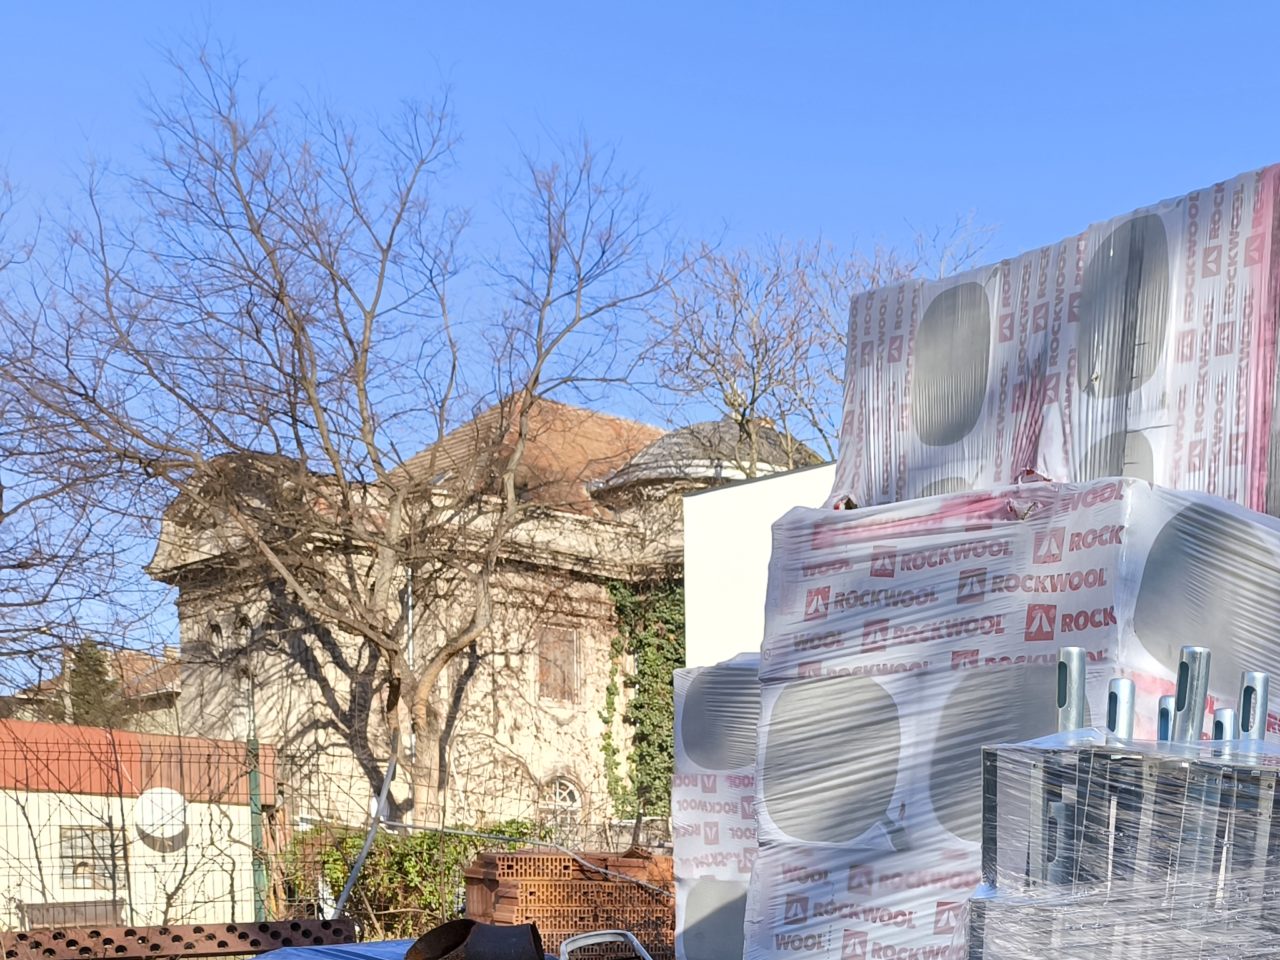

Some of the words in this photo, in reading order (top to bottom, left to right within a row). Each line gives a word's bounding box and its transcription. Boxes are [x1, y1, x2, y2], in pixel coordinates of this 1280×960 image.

[1184, 192, 1199, 323] ROCKWOOL
[1223, 184, 1244, 315] ROCKWOOL
[1048, 245, 1067, 367] ROCKWOOL
[1069, 525, 1125, 552] ROCK
[901, 540, 1013, 571] ROCKWOOL
[991, 568, 1107, 593] ROCKWOOL
[834, 587, 939, 609] ROCKWOOL
[1061, 606, 1117, 633] ROCK
[813, 902, 917, 929] ROCKWOOL
[775, 933, 826, 950] WOOL
